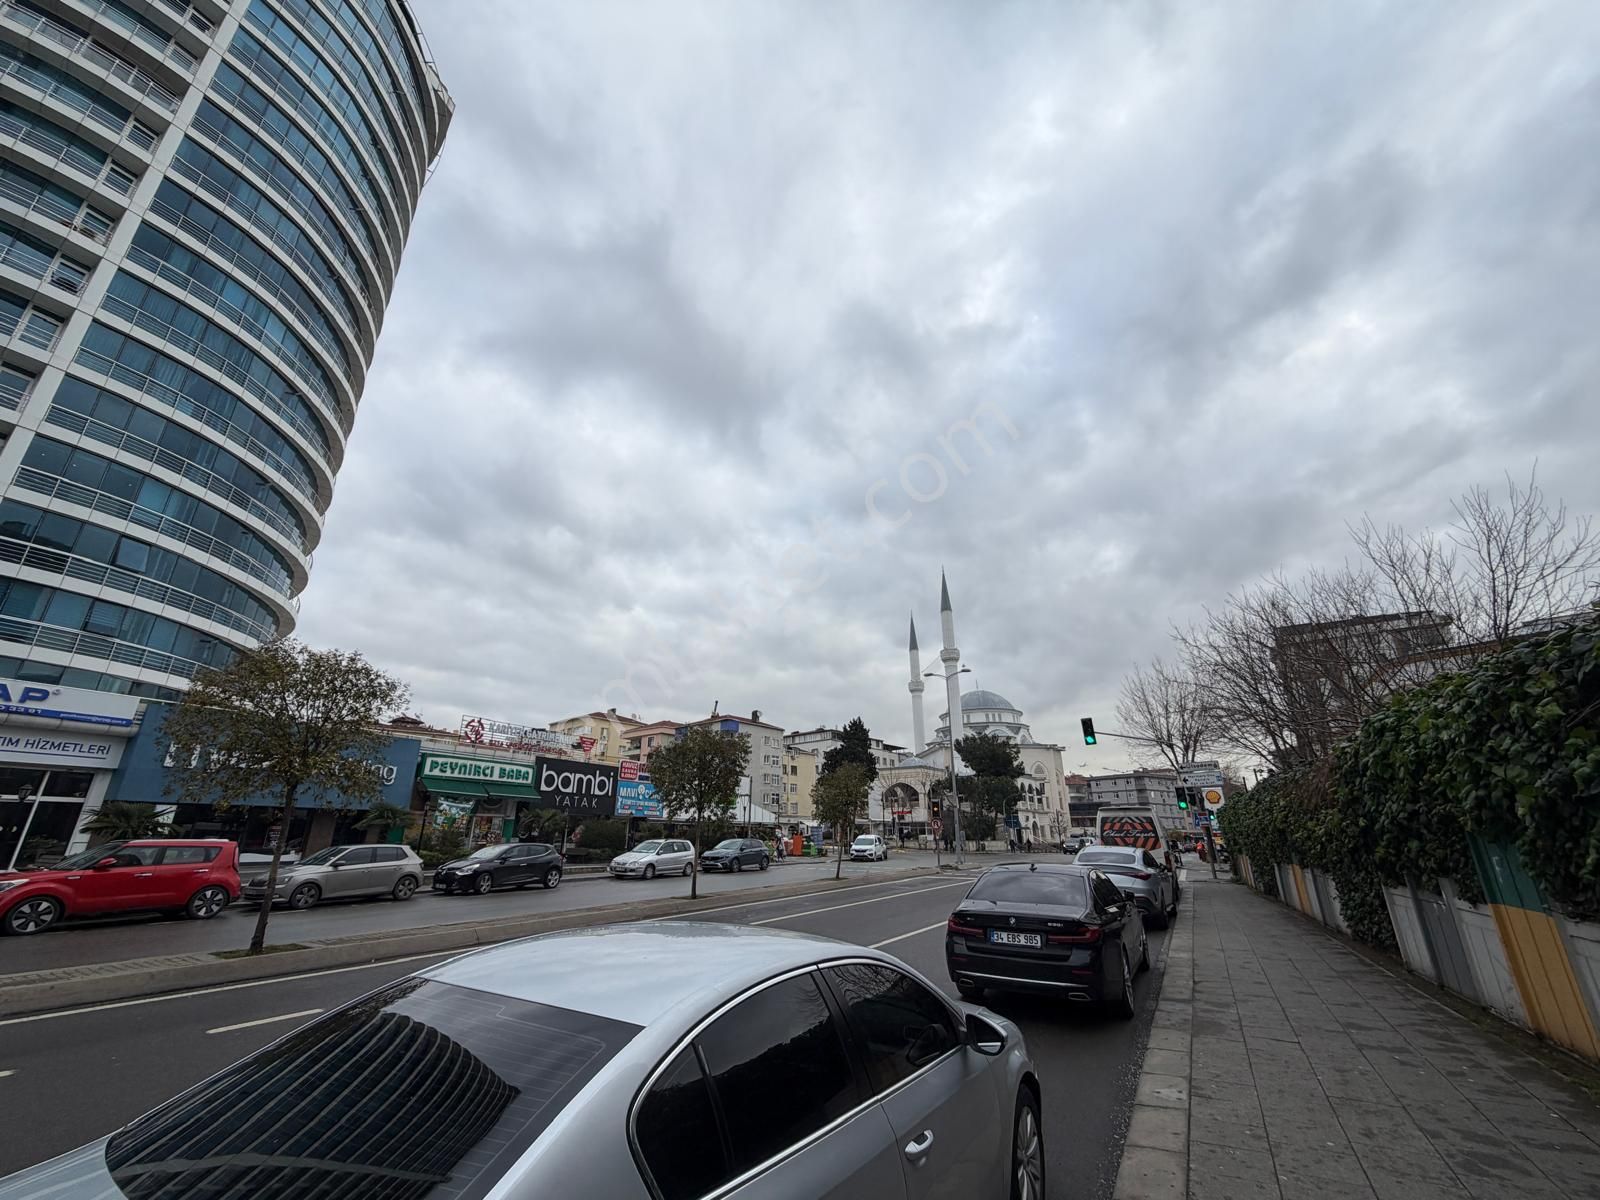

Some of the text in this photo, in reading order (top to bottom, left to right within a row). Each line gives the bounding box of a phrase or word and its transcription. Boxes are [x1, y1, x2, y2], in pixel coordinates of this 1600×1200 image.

[24, 737, 112, 755] HİZMETLERİ
[498, 767, 530, 782] BABA
[540, 764, 614, 797] bambi
[555, 795, 599, 808] YATAK
[994, 932, 1039, 944] 34 EBS 985
